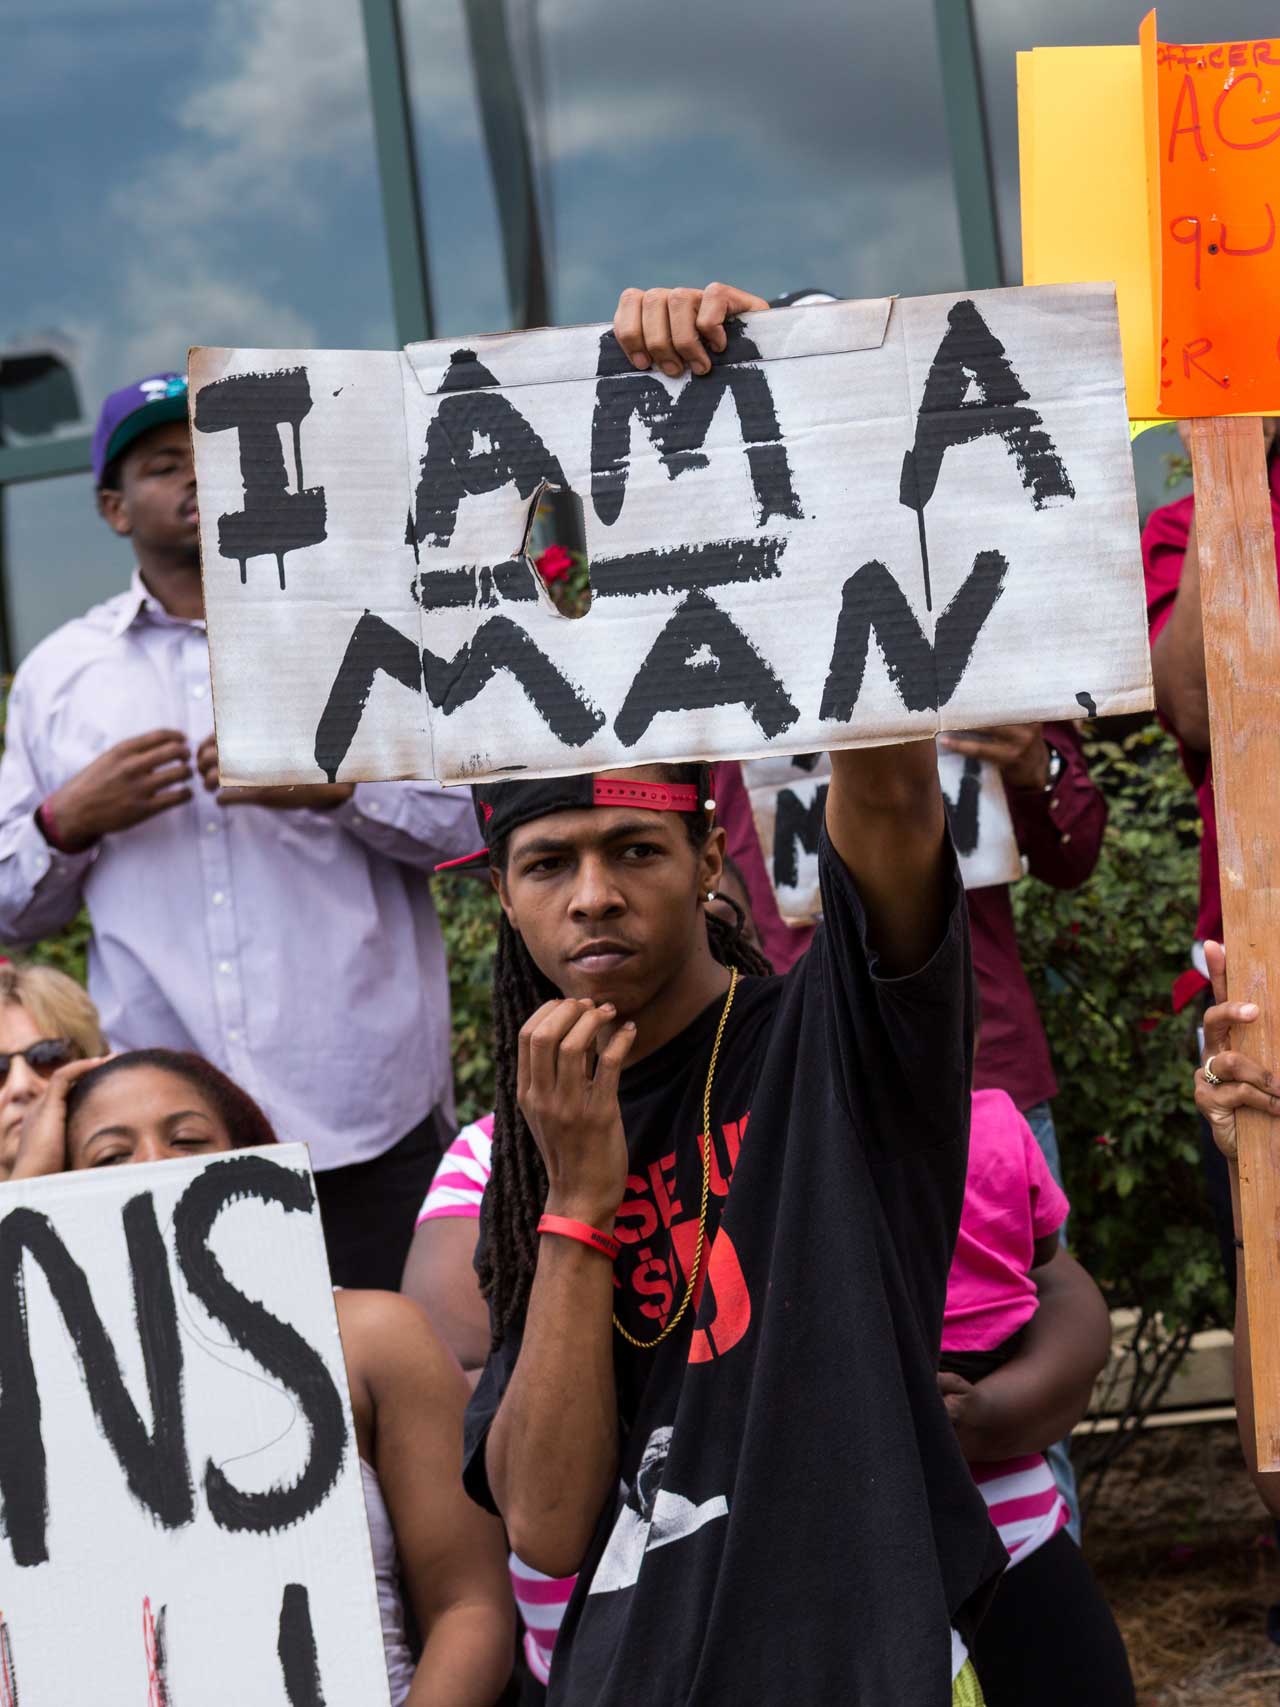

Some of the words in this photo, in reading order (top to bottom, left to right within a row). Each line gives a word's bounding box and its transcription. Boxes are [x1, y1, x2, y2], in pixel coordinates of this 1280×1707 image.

[195, 364, 327, 588] I
[405, 318, 804, 547] AM
[899, 299, 1076, 518] A
[313, 550, 1010, 783] MAN
